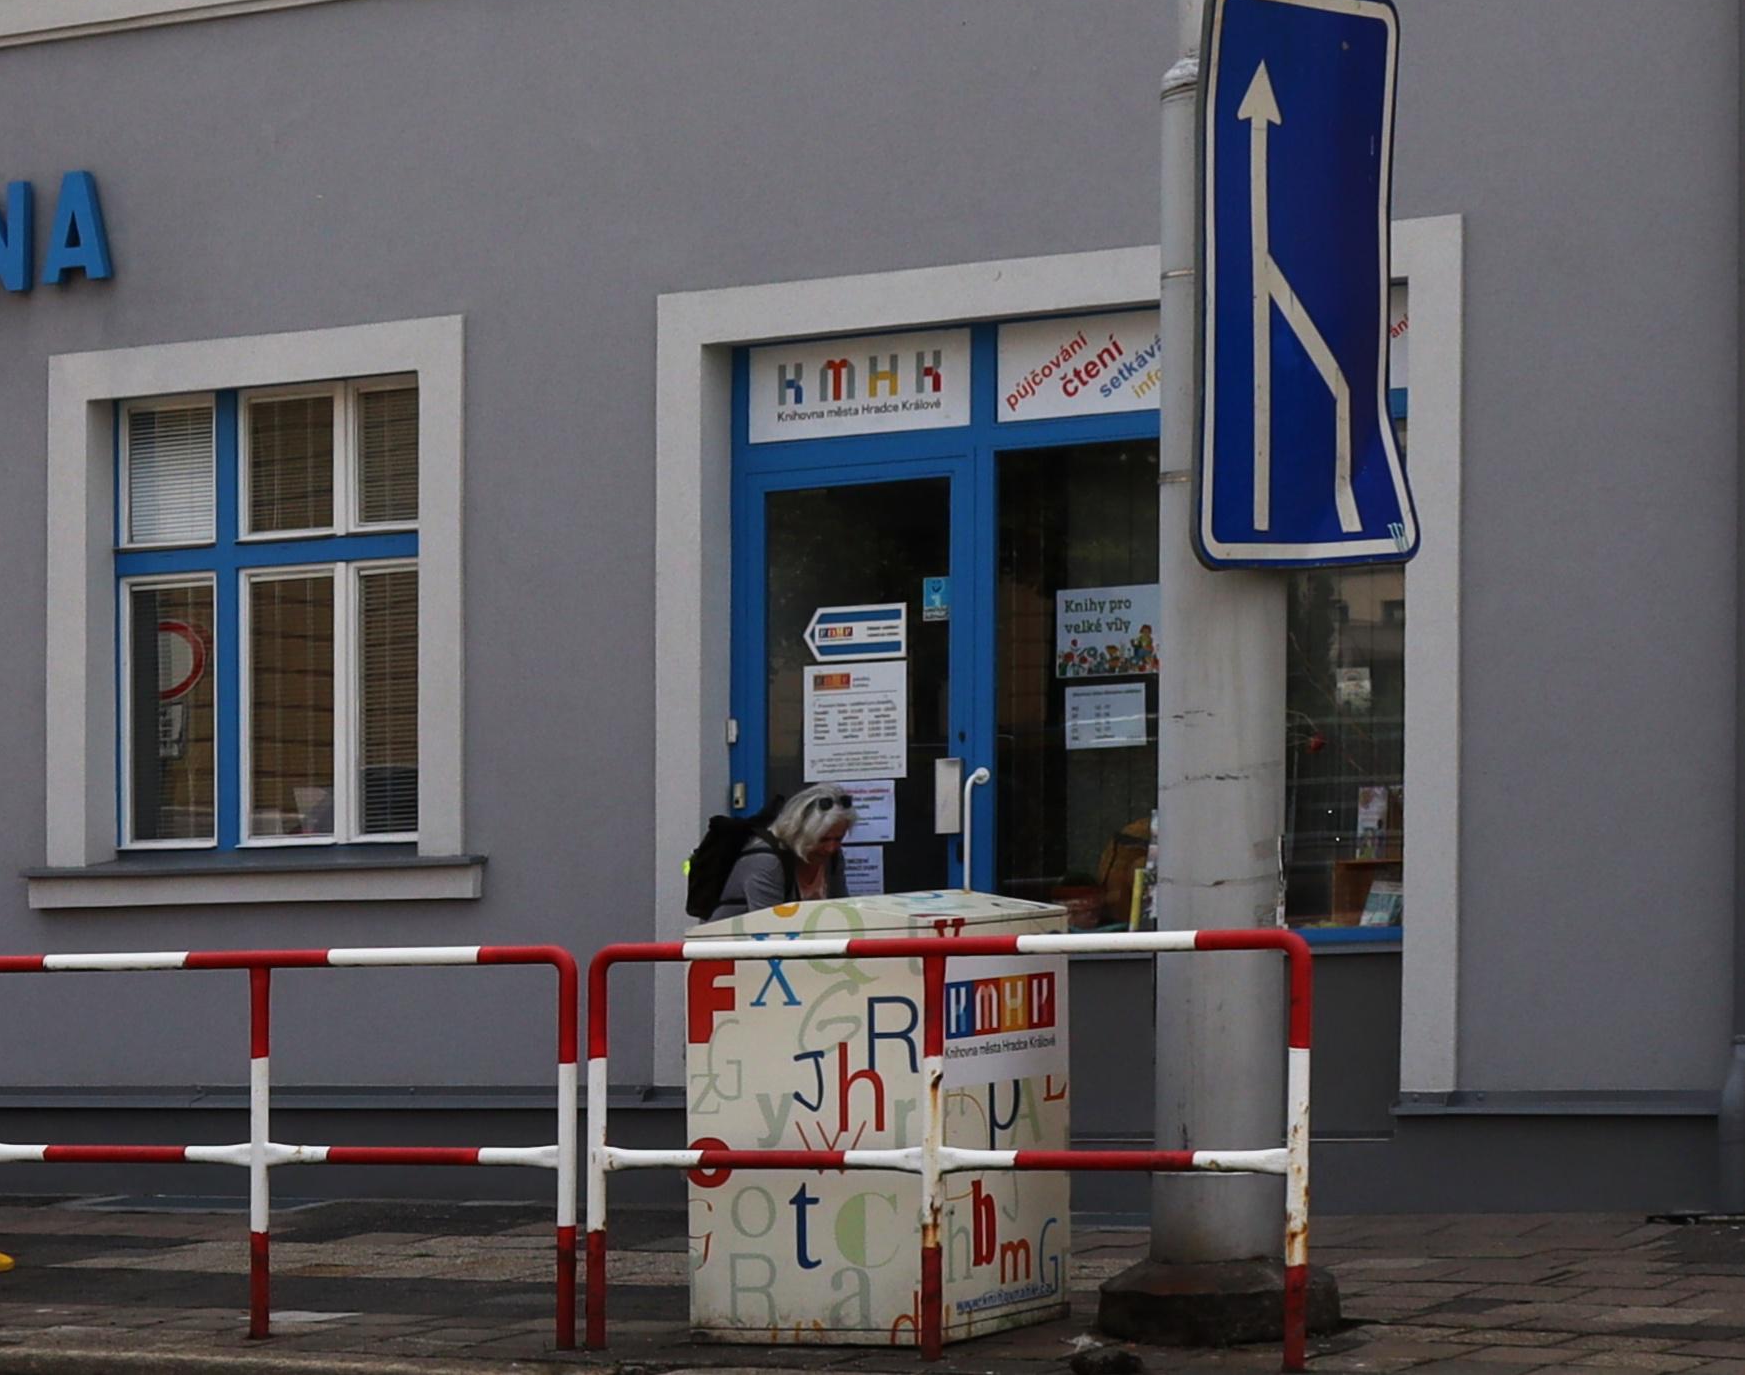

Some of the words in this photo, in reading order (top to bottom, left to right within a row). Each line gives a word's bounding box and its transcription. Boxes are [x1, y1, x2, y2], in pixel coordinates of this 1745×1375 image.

[778, 350, 942, 406] KMHK
[1005, 330, 1089, 411] půjčování
[1061, 333, 1125, 399] čtení
[776, 409, 825, 423] Knihovna
[826, 406, 859, 418] města
[861, 402, 899, 415] Hradce
[901, 399, 942, 412] Králové
[1064, 598, 1106, 614] Knihy
[1109, 598, 1132, 614] pro
[1064, 617, 1103, 634] velké
[1106, 617, 1132, 634] víly
[946, 1045, 978, 1059] Knihovna
[979, 1041, 1001, 1054] města
[788, 1182, 823, 1269] t
